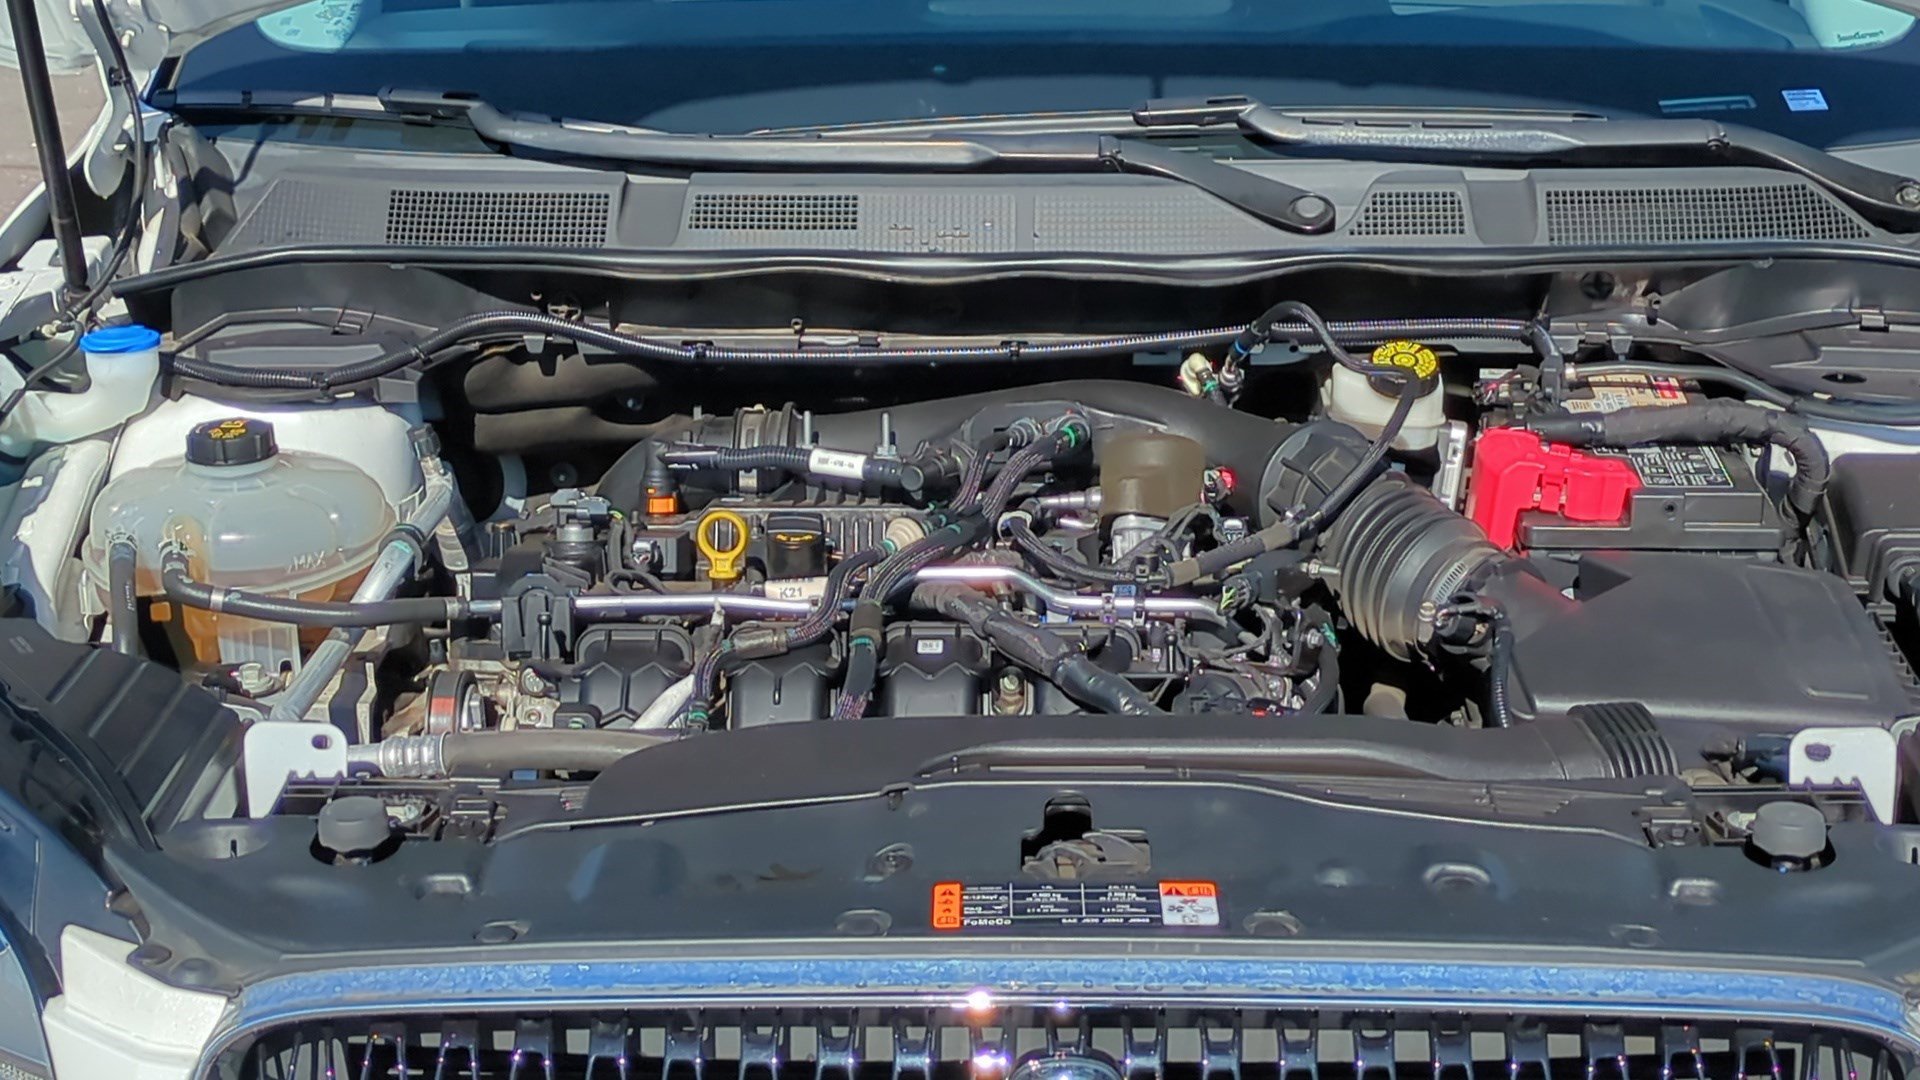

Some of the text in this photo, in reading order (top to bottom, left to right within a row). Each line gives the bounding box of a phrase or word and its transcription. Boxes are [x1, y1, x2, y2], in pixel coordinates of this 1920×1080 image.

[287, 550, 326, 574] MAX
[779, 586, 803, 599] K21
[963, 918, 1012, 926] FoMoCo
